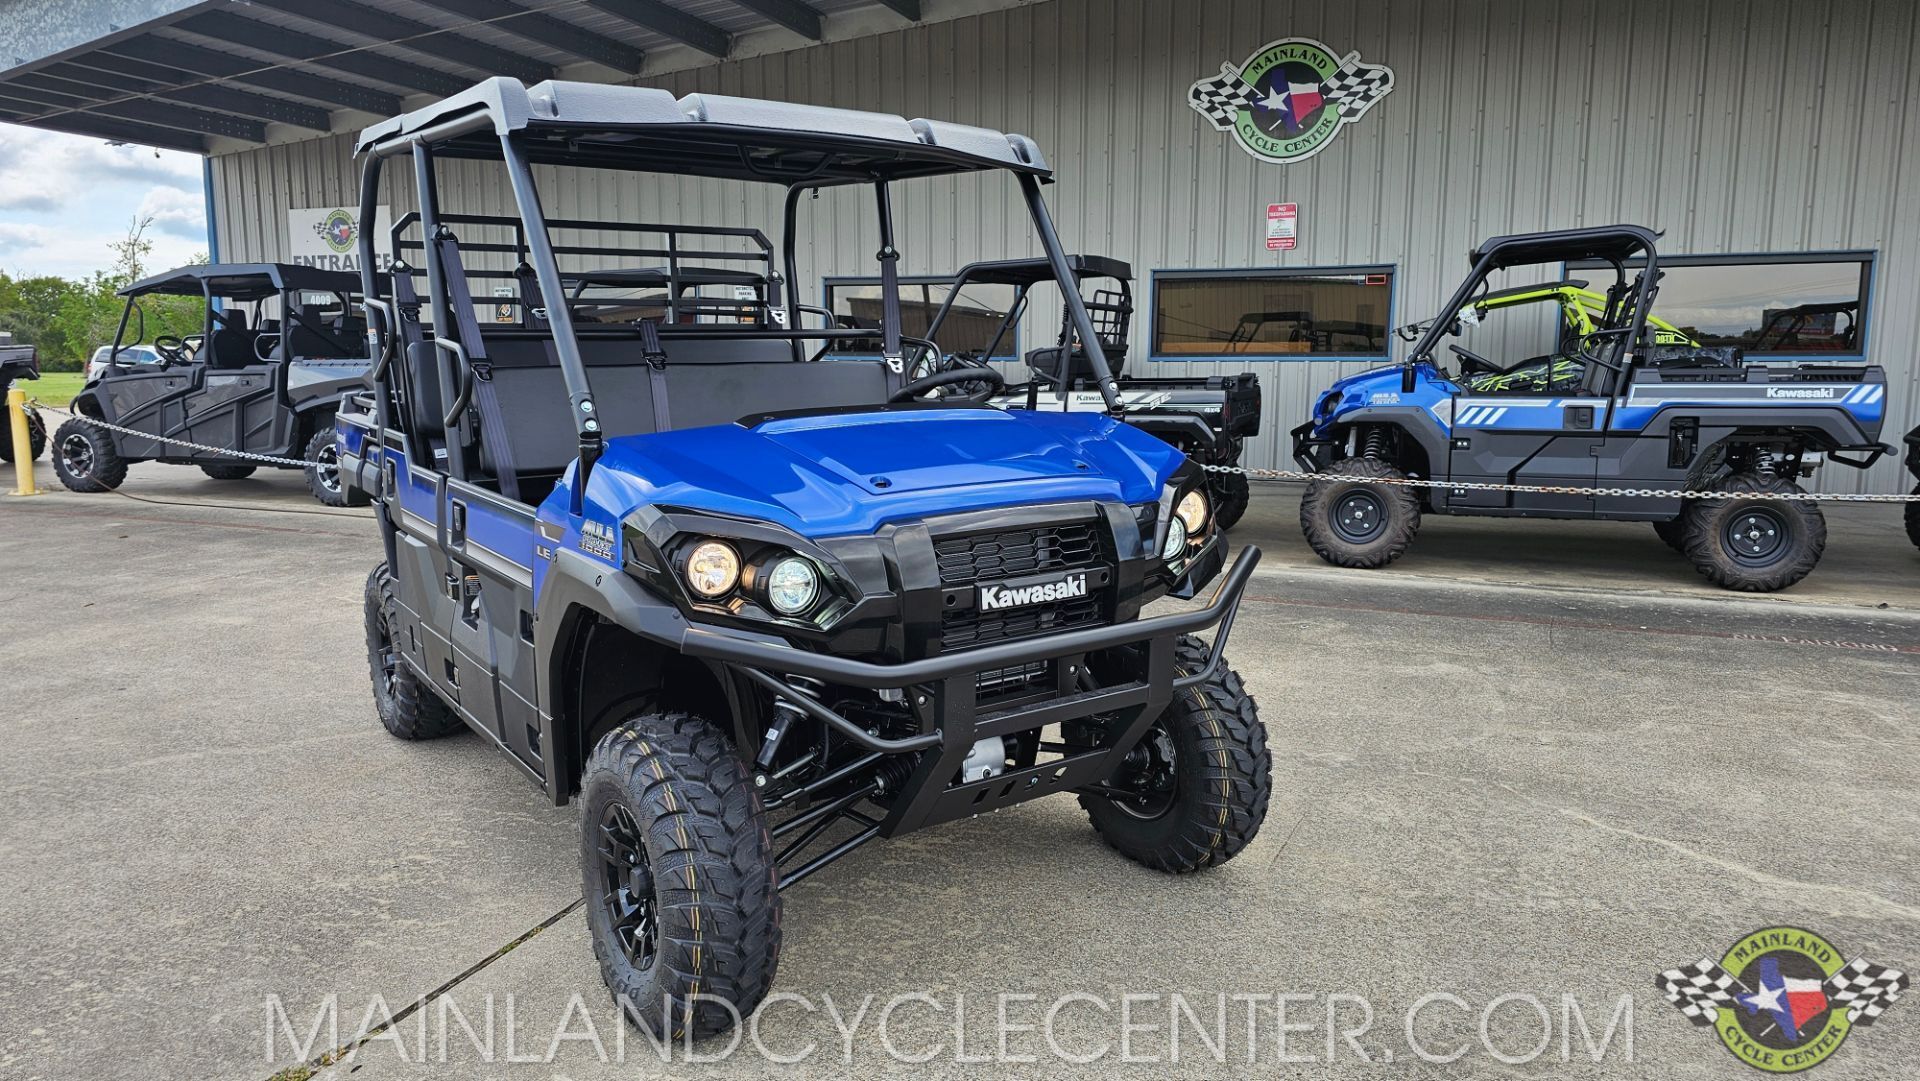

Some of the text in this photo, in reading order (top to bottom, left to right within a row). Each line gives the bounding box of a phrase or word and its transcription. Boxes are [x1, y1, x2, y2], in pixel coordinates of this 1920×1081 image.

[1252, 48, 1328, 75] MAINLAND
[1242, 117, 1333, 153] CYCLE CENTER
[293, 253, 391, 270] ENTRAE
[1766, 387, 1834, 398] Kawasaki
[536, 545, 551, 560] LE
[981, 573, 1086, 611] Kawasaki
